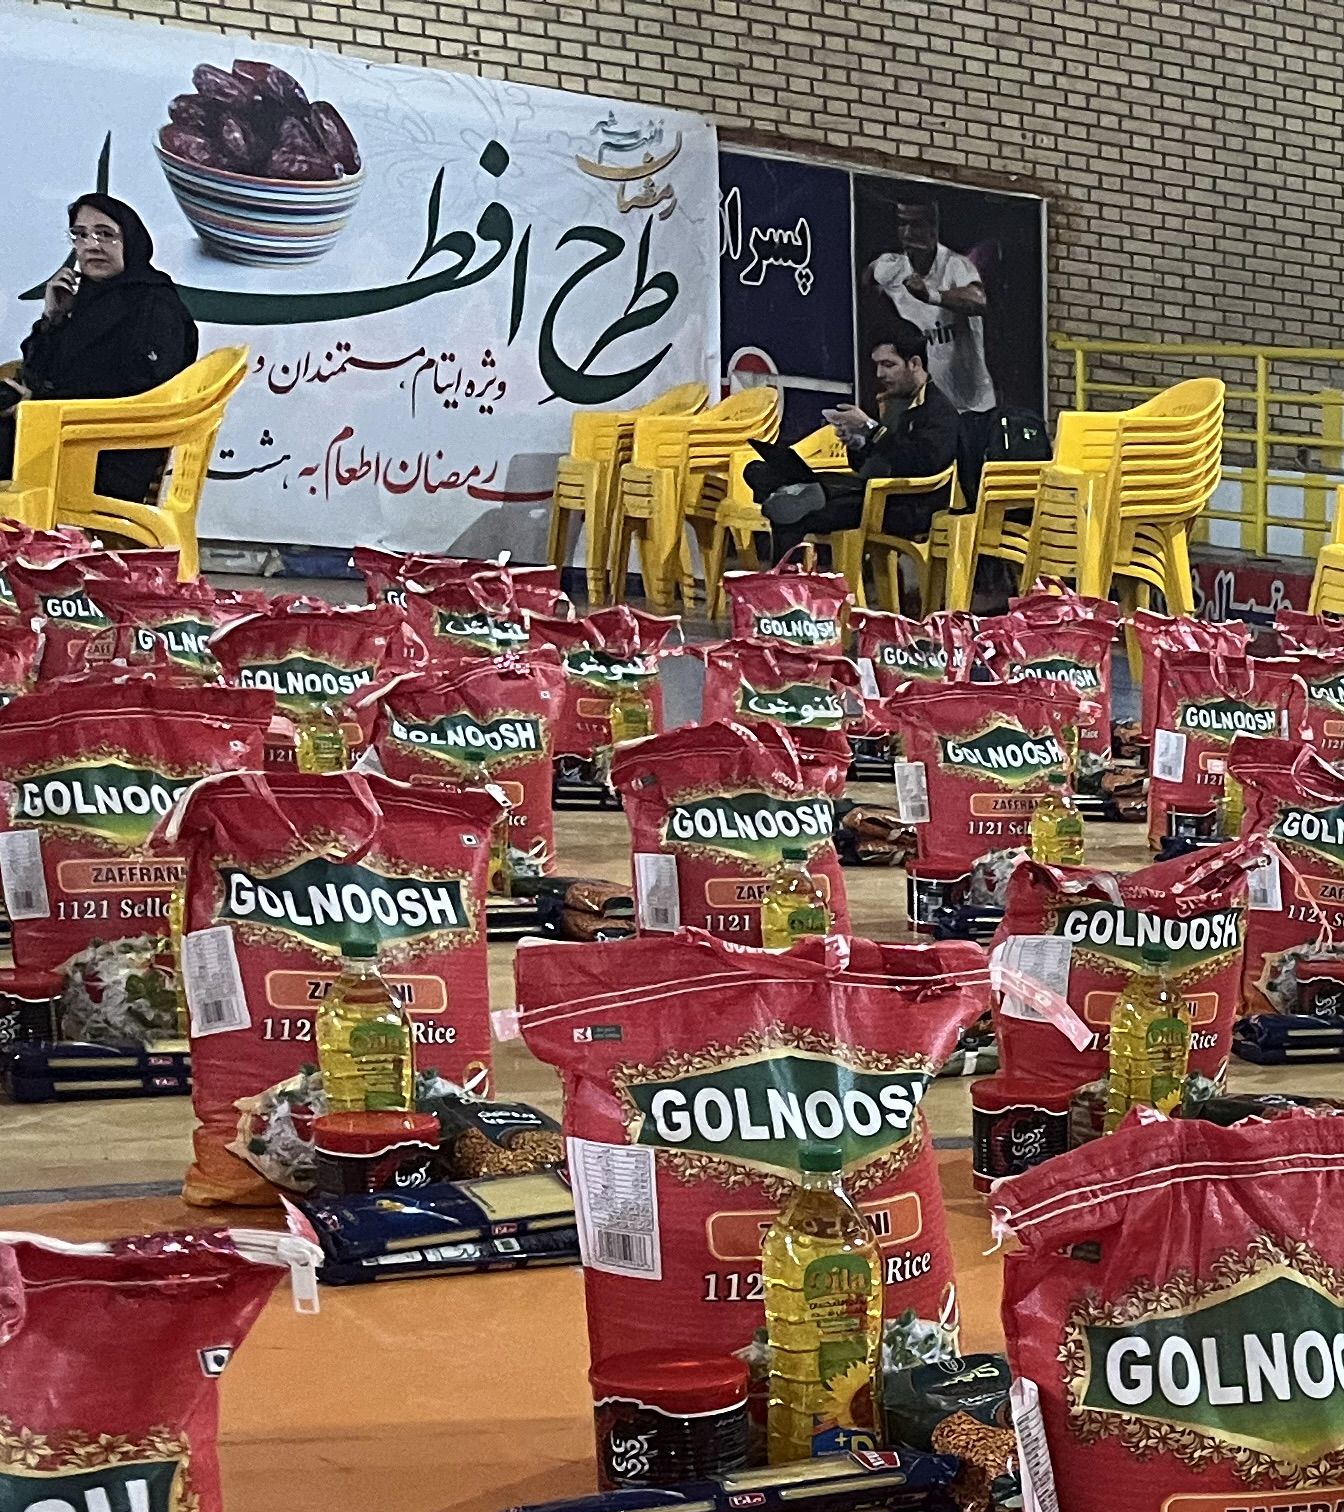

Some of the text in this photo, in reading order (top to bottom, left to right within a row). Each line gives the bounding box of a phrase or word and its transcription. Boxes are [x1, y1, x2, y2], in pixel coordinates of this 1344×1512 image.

[540, 215, 680, 405] طرح
[267, 340, 426, 395] مستمندان
[464, 348, 507, 415] ویژه
[382, 448, 498, 496] رمضان
[1186, 707, 1276, 731] GOLNOOSH
[948, 740, 1060, 770] GOLNOOSH
[672, 803, 834, 842] GOLNOOSH
[56, 899, 109, 921] 1121
[230, 873, 457, 926] GOLNOOSH
[705, 915, 751, 931] 1121
[1064, 910, 1238, 949] GOLNOOSH
[262, 1018, 456, 1044] 112 Rice
[1188, 1031, 1218, 1050] Rice
[704, 1251, 931, 1301] 112 Rice
